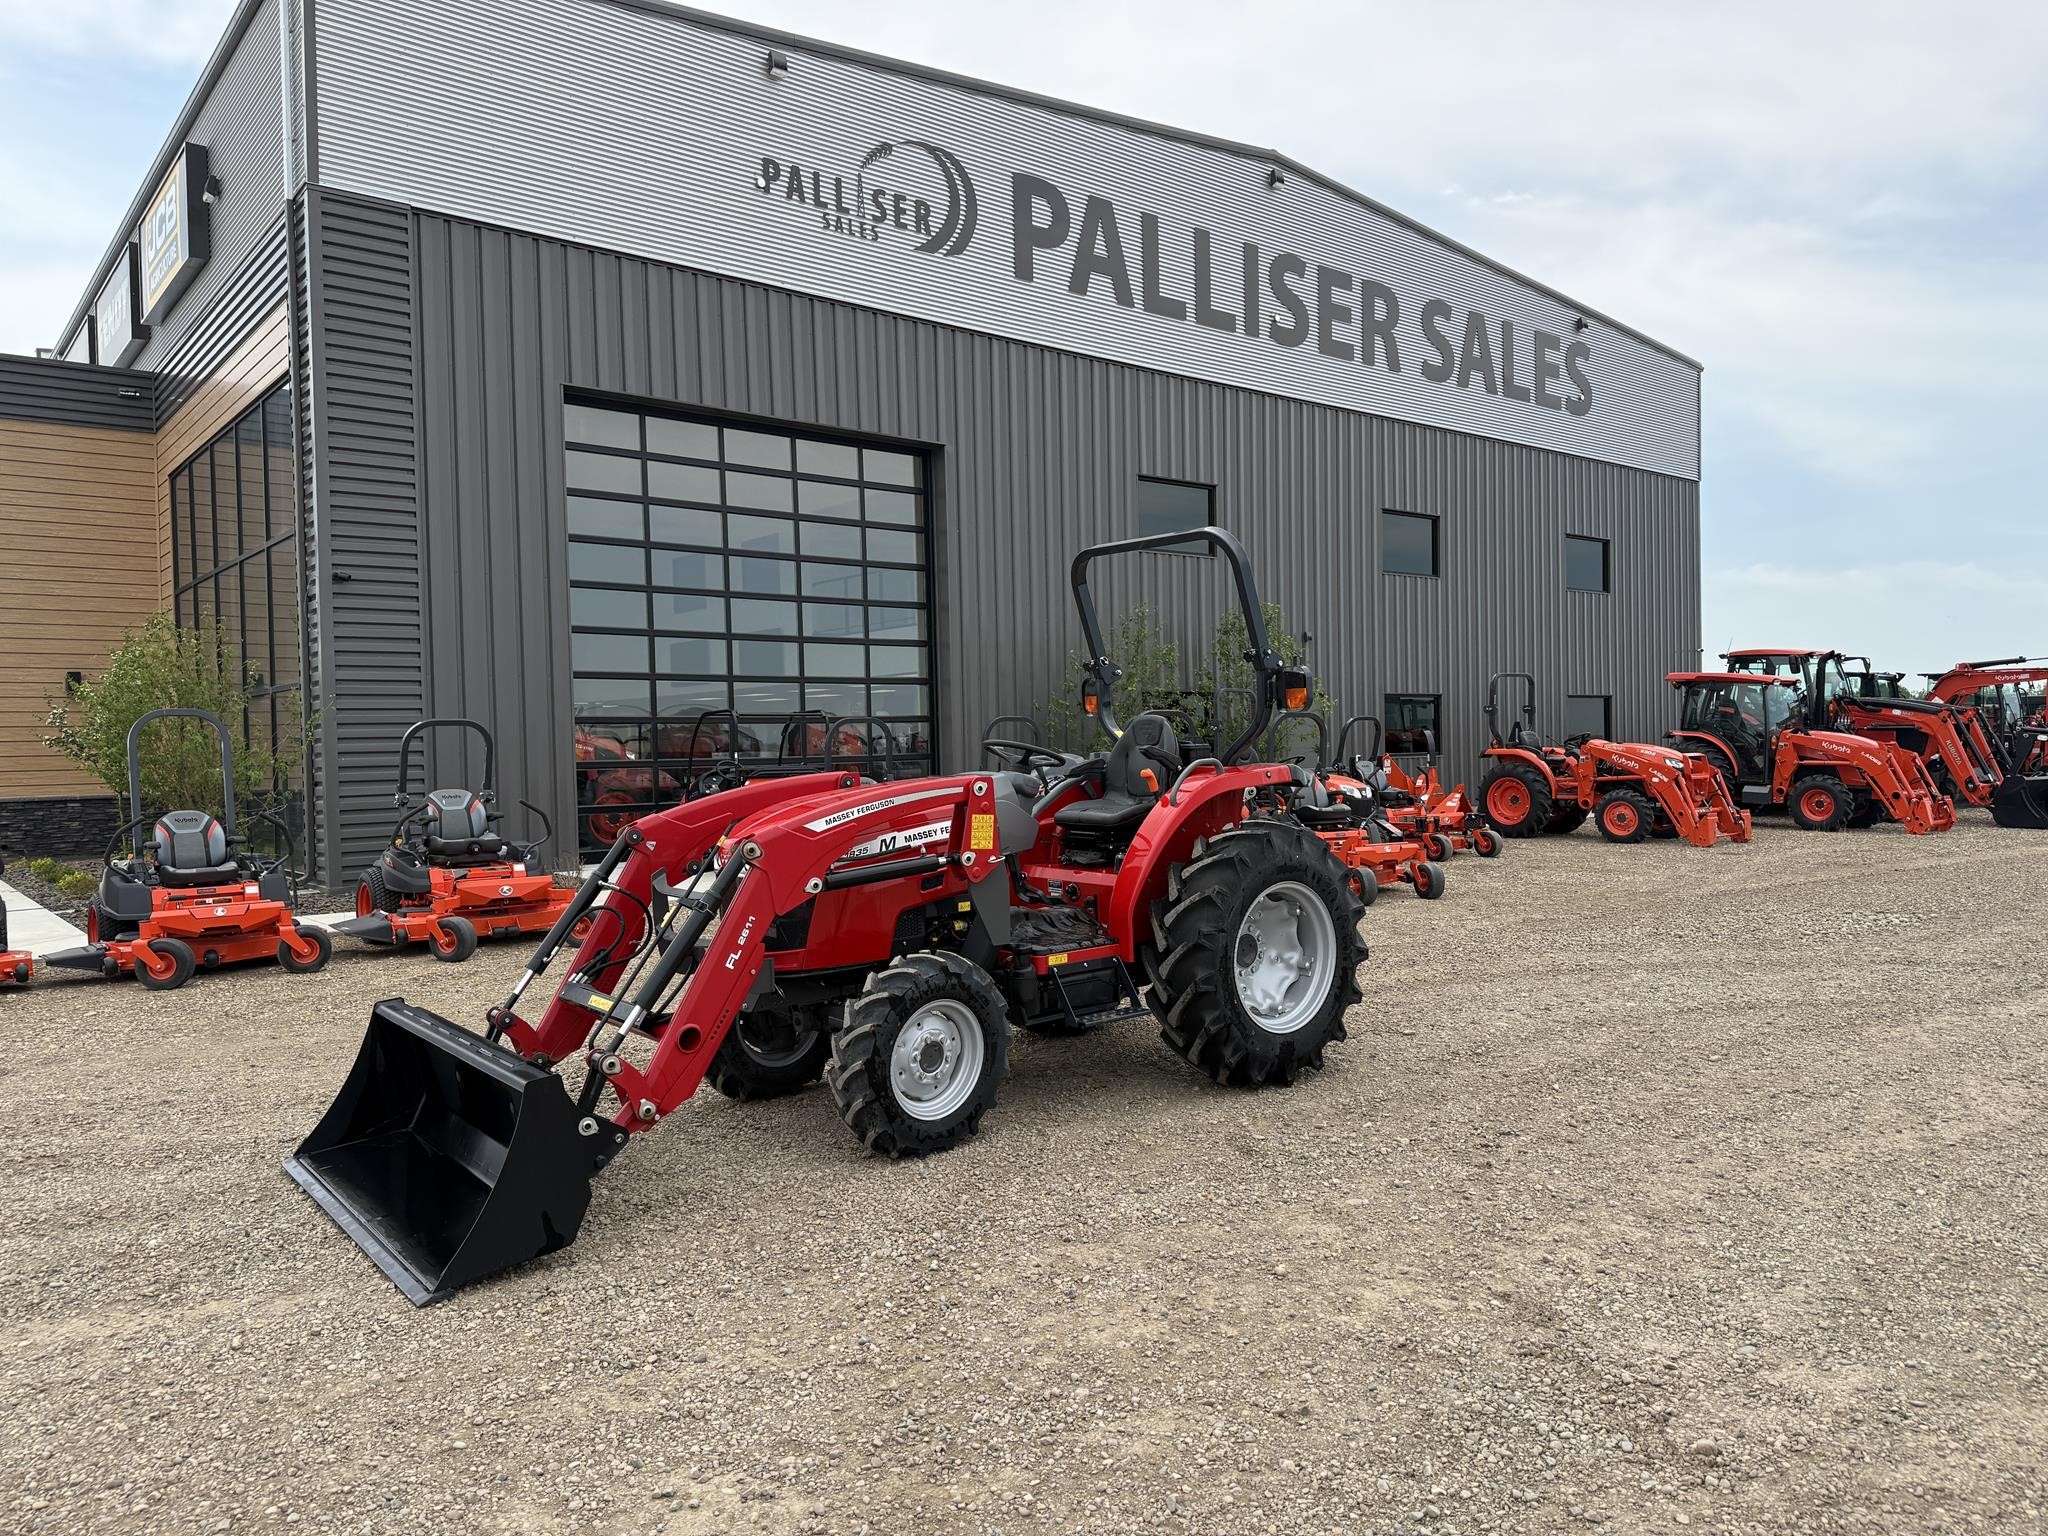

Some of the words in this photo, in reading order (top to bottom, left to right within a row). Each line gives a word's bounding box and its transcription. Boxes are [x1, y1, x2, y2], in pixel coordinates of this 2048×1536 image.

[761, 157, 932, 238] PALLISER
[148, 182, 177, 263] JCB
[822, 211, 879, 242] SALES
[1012, 173, 1401, 373] PALLISER
[1421, 297, 1592, 416] SALES
[1995, 673, 2021, 681] Kubota
[1611, 754, 1639, 769] Kubota
[1821, 741, 1851, 754] Kubota
[1945, 739, 1962, 765] KUBOTA
[825, 809, 855, 826] MASSEY
[856, 798, 895, 815] FERGUSON
[879, 835, 897, 853] M
[904, 828, 938, 844] MASSEY
[725, 949, 742, 970] FL
[737, 915, 756, 946] 2611
